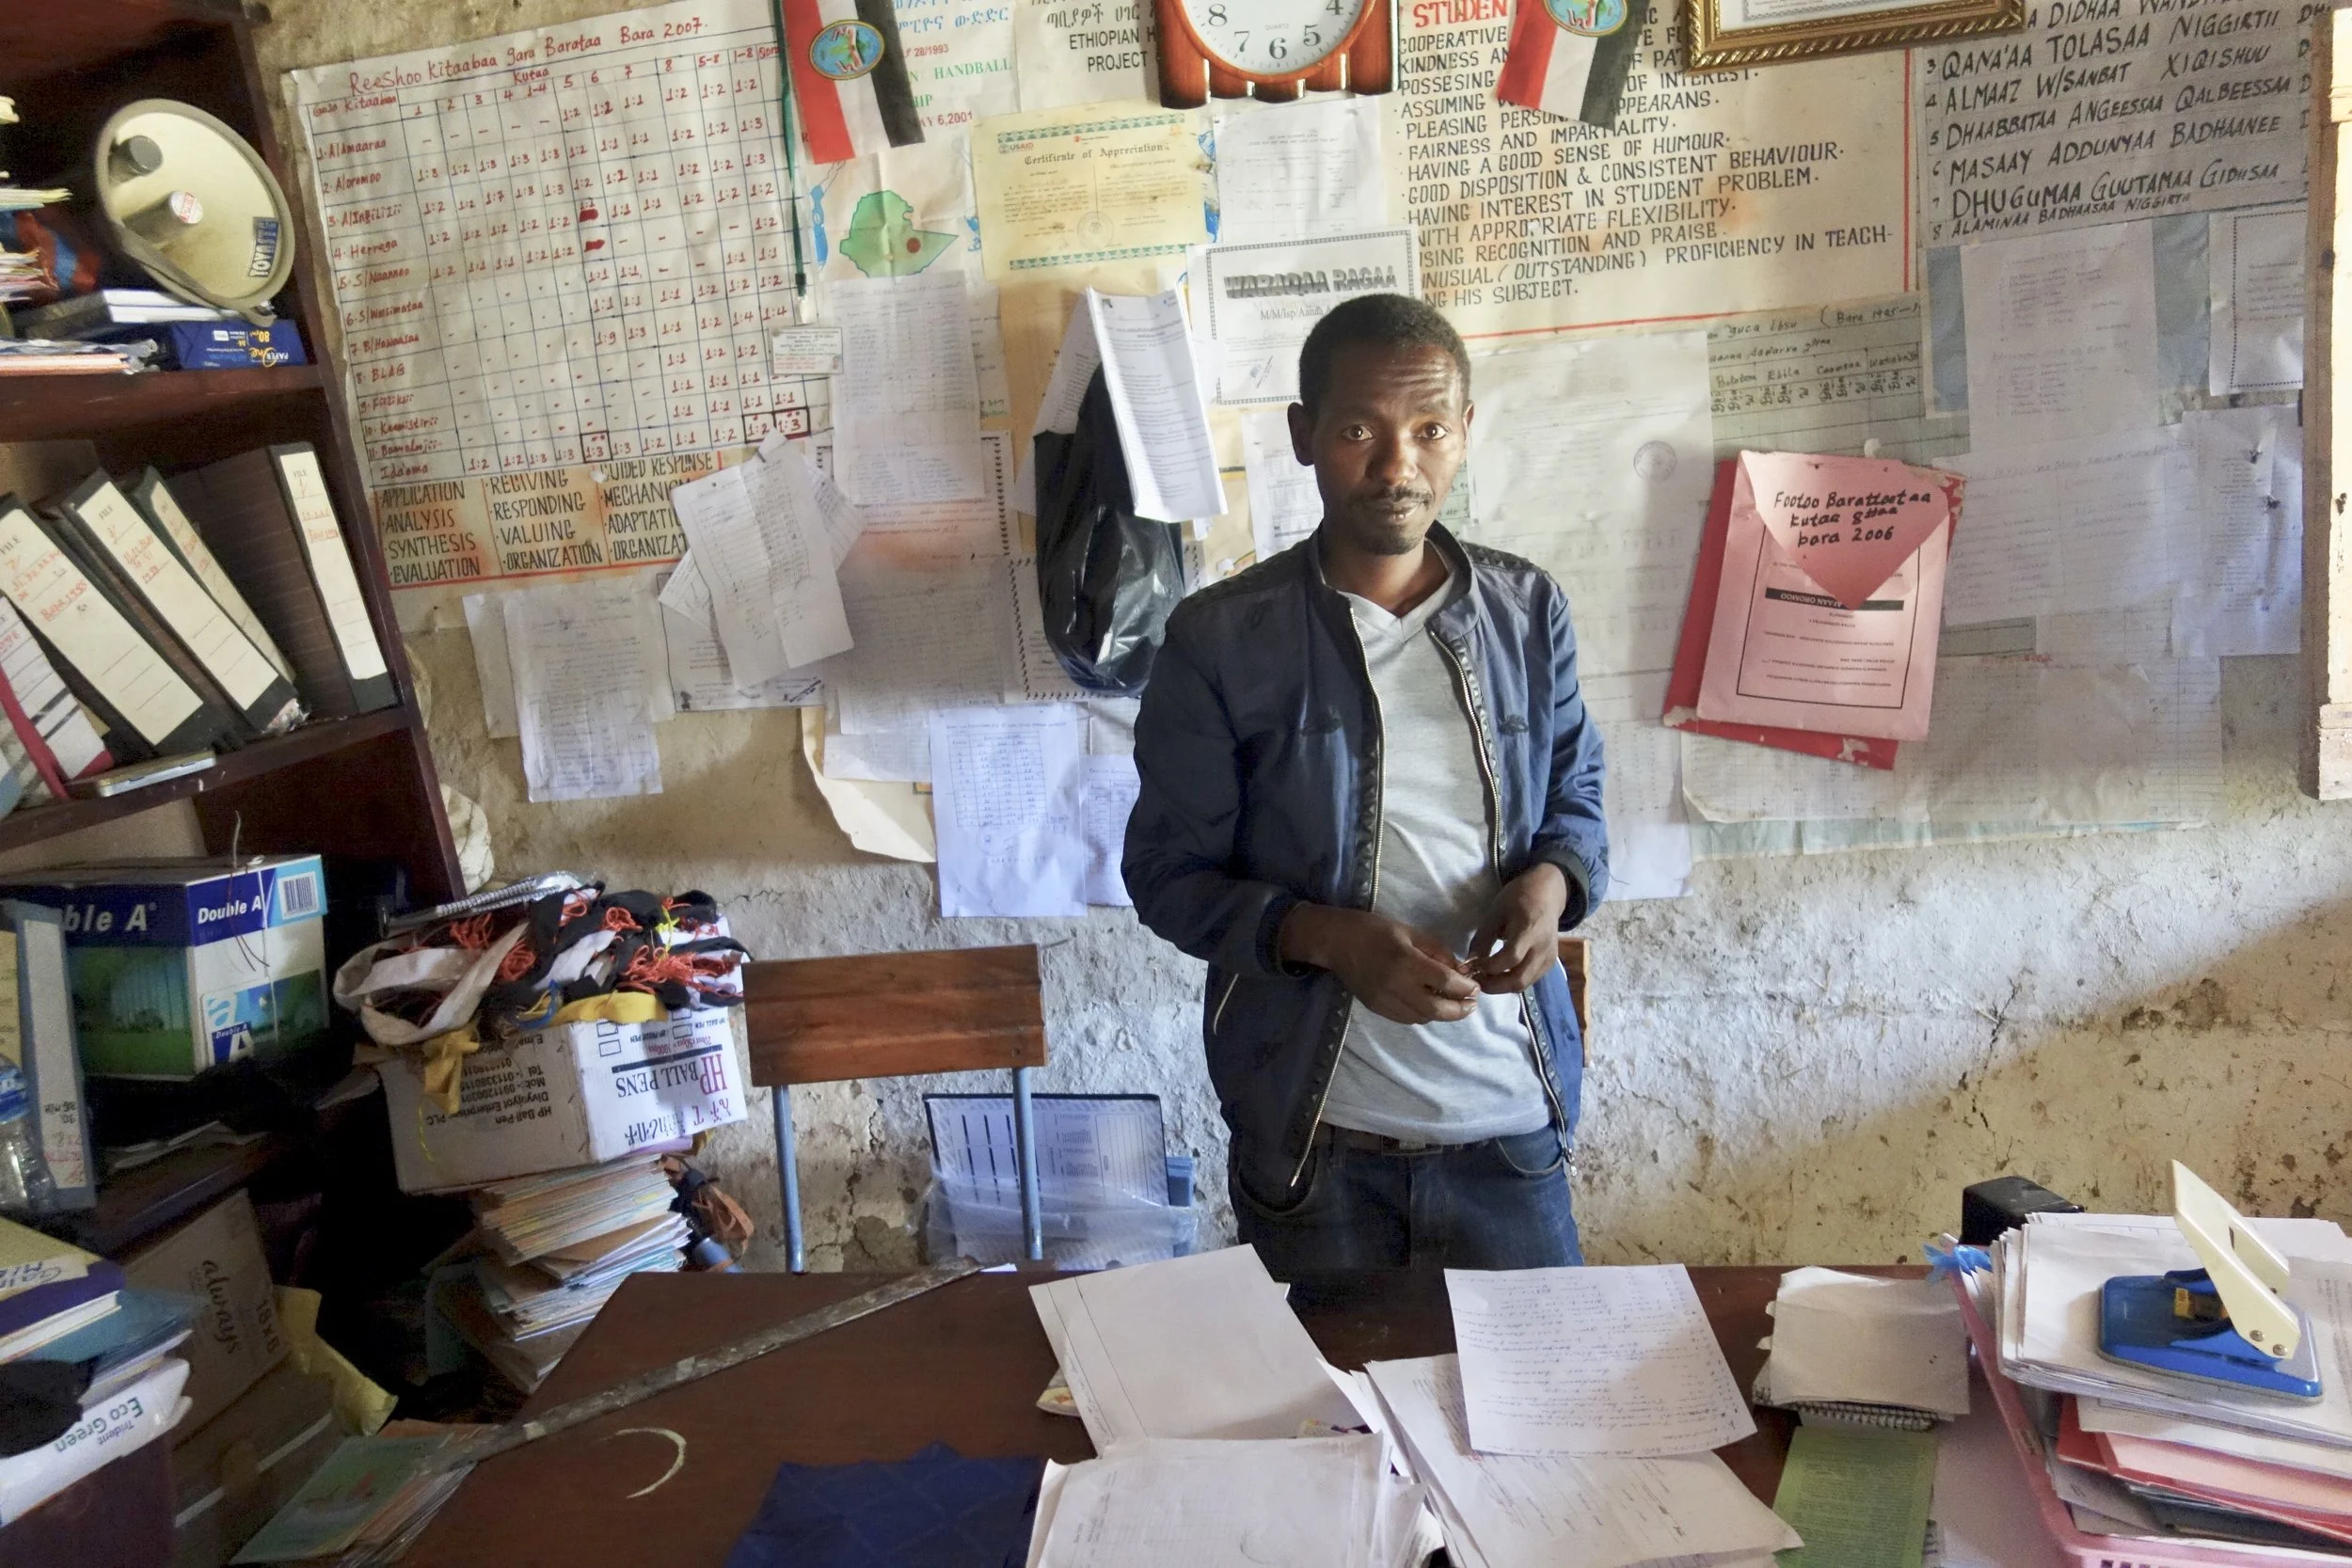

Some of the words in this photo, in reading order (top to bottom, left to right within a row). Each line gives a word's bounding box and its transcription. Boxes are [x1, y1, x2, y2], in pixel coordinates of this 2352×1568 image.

[1208, 3, 1228, 27] 8
[1326, 0, 1343, 15] 4
[1413, 0, 1507, 28] STUDEN
[620, 25, 656, 45] Bara
[1069, 27, 1139, 50] ETHIOPIAN
[1234, 30, 1250, 53] 7
[1269, 38, 1288, 59] 6
[1303, 24, 1322, 46] 5
[1926, 58, 1936, 75] 3
[2046, 23, 2151, 64] TOLASAA
[933, 58, 1013, 80] HANDBALL
[1088, 51, 1148, 72] PROJECT
[1399, 50, 1479, 75] KINDNESS
[1400, 71, 1495, 95] POSSESING
[1946, 79, 2023, 115] ALMAAZ
[1401, 93, 1486, 119] ASSUMING
[1406, 116, 1487, 140] PLEASING
[1082, 149, 1092, 160] of
[1407, 160, 1472, 182] HAVING
[1480, 156, 1492, 174] A
[1498, 150, 1543, 172] GOOD
[1553, 143, 1611, 165] SENSE
[1623, 140, 1643, 157] OF
[1653, 132, 1731, 154] HUMOUR.
[1408, 137, 1491, 161] FAIRNESS
[1500, 131, 1537, 150] AND
[1407, 182, 1450, 205] GOOD
[1460, 168, 1568, 199] DISPOSITION
[1577, 166, 1593, 185] &
[1600, 153, 1718, 183] CONSISTENT
[1730, 141, 1845, 169] BEHAVIOUR.
[1949, 149, 2033, 186] MASAAY
[1407, 204, 1470, 227] HAVING
[1480, 191, 1574, 219] INTEREST
[1585, 188, 1604, 209] IN
[1614, 177, 1704, 206] STUDENT
[1718, 166, 1820, 194] PROBLEM.
[1952, 182, 2082, 220] DHUGUMAA
[1607, 198, 1737, 229] FLEXIBILITY.
[1475, 234, 1591, 263] RECOGNITION
[1602, 230, 1641, 250] AND
[1666, 236, 1785, 264] PROFICIENCY
[1795, 232, 1815, 251] IN
[1331, 265, 1398, 293] RAGAA
[1454, 289, 1482, 307] HIS
[1492, 278, 1579, 304] SUBJECT.
[380, 479, 466, 509] APPLICATION
[492, 490, 586, 521] RESPONDING
[385, 508, 456, 534] ANALYSIS
[500, 518, 577, 546] VALUING
[1851, 525, 1895, 543] 2006
[388, 531, 477, 561] SYNTHESIS
[504, 542, 604, 572] ORGANIZATION
[612, 532, 689, 562] ORGANIZAT
[392, 556, 482, 585] EVALUATION
[125, 904, 148, 931] A
[197, 900, 247, 926] Double
[251, 895, 262, 914] A
[615, 1069, 660, 1099] PENS
[660, 1060, 699, 1087] BALL
[699, 1053, 728, 1096] HP
[109, 1396, 145, 1419] Eco
[54, 1417, 107, 1454] Green
